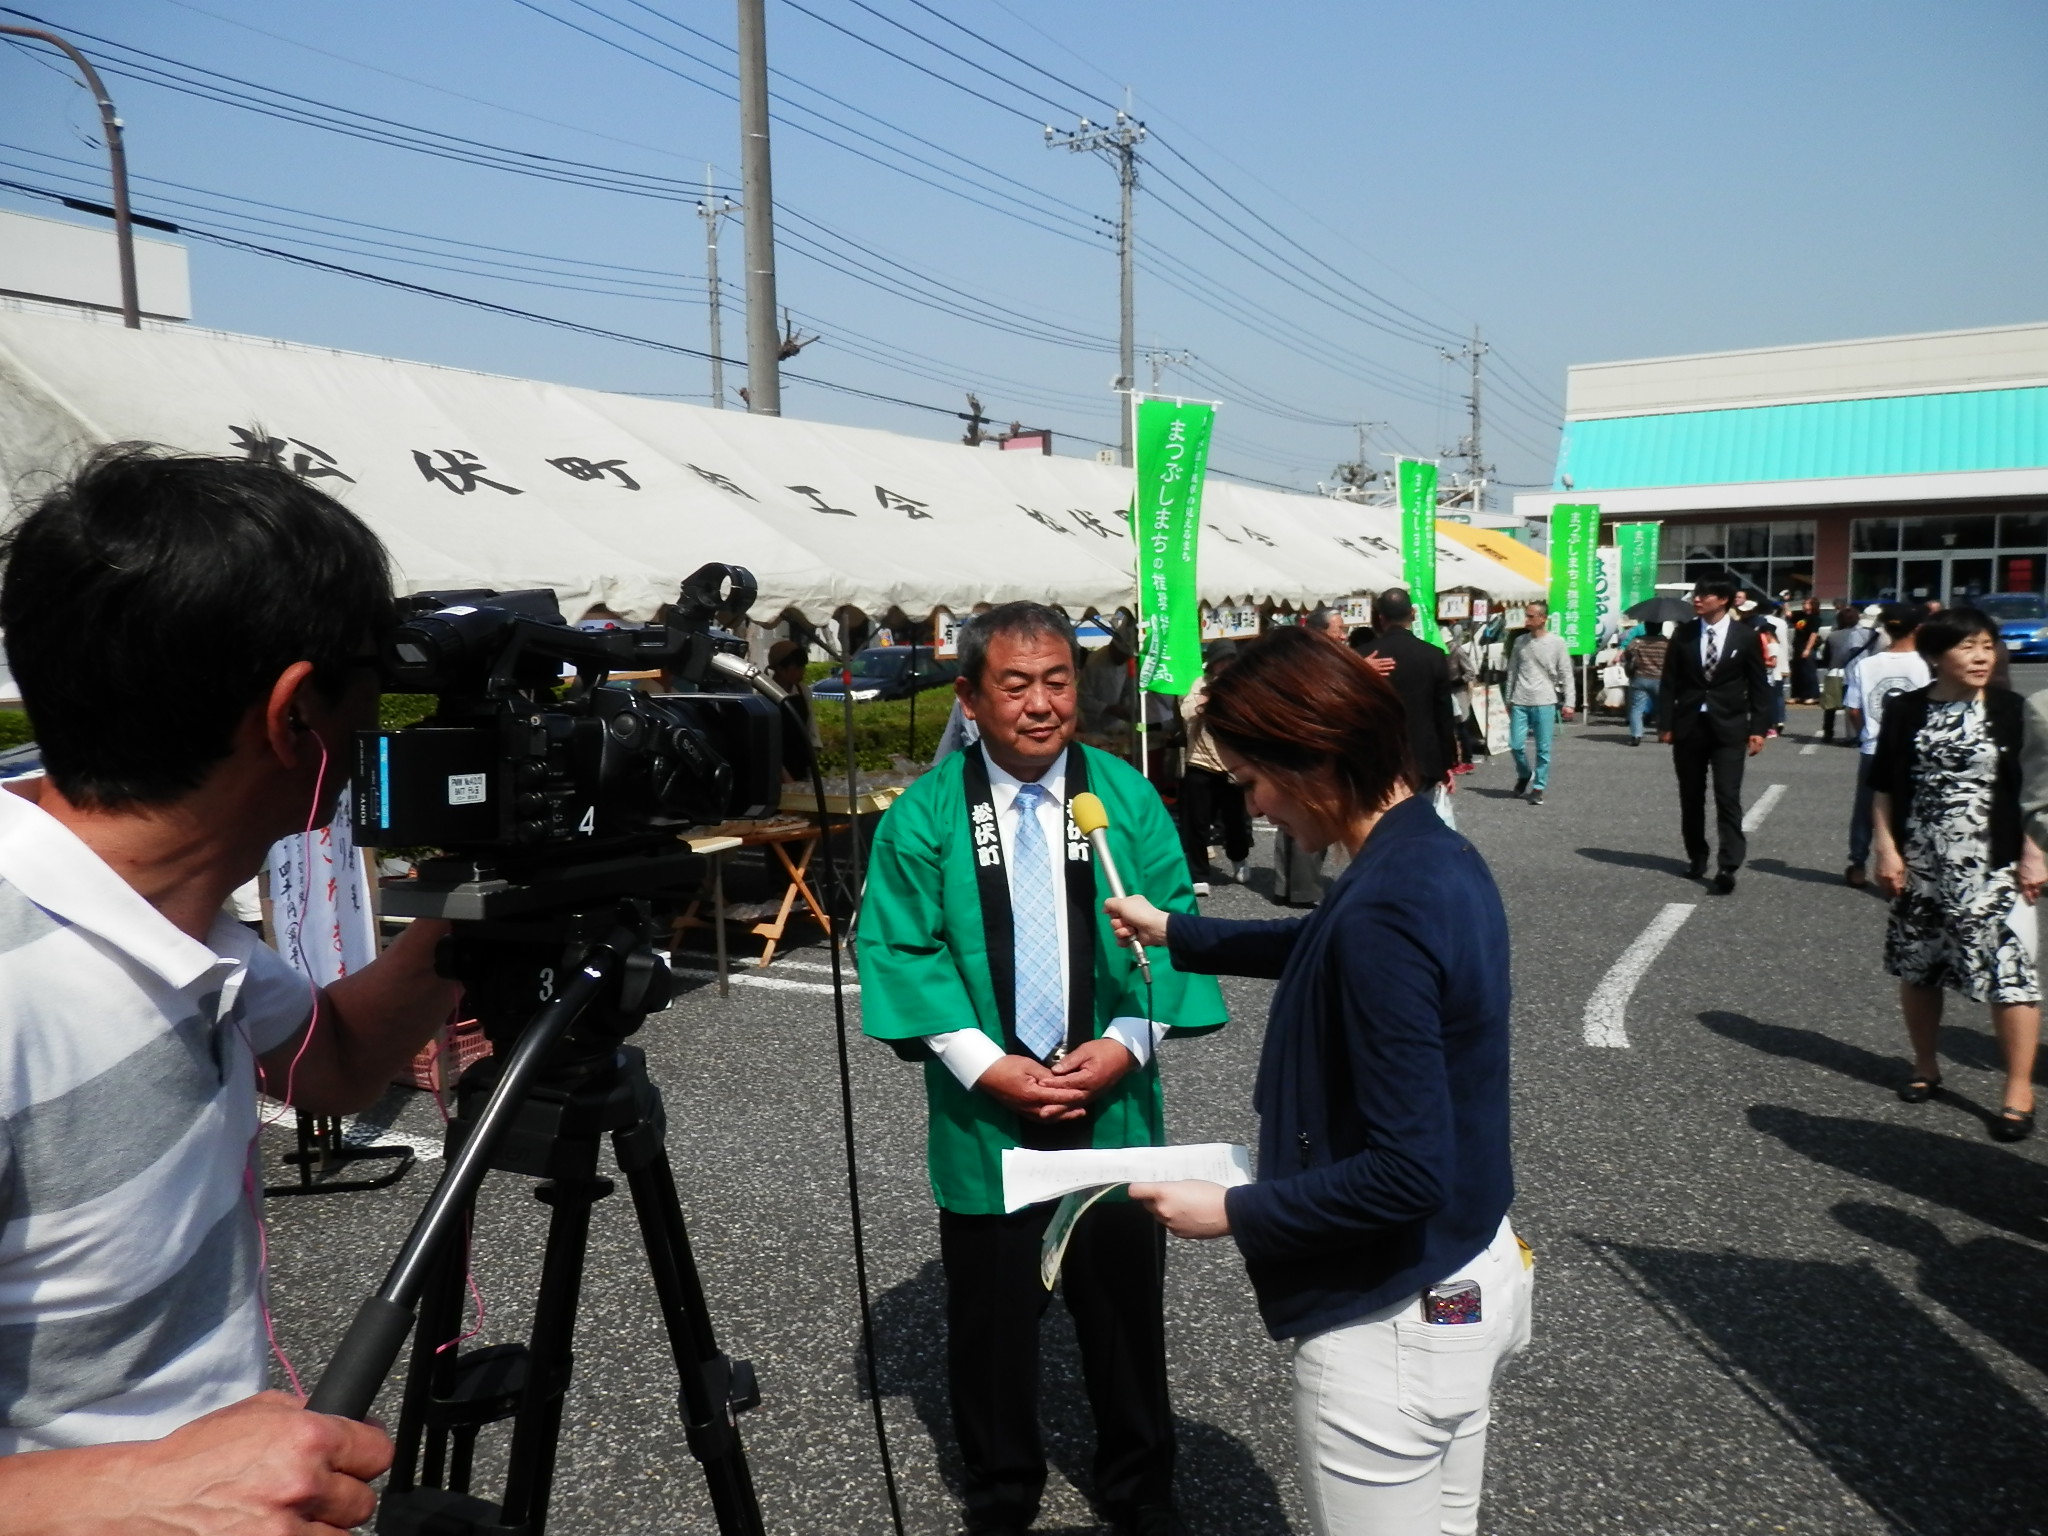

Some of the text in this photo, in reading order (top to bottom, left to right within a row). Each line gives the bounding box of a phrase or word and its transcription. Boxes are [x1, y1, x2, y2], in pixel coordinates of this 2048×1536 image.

[578, 805, 595, 836] 4
[972, 801, 1000, 867] 松伏町
[539, 967, 554, 1002] 3
